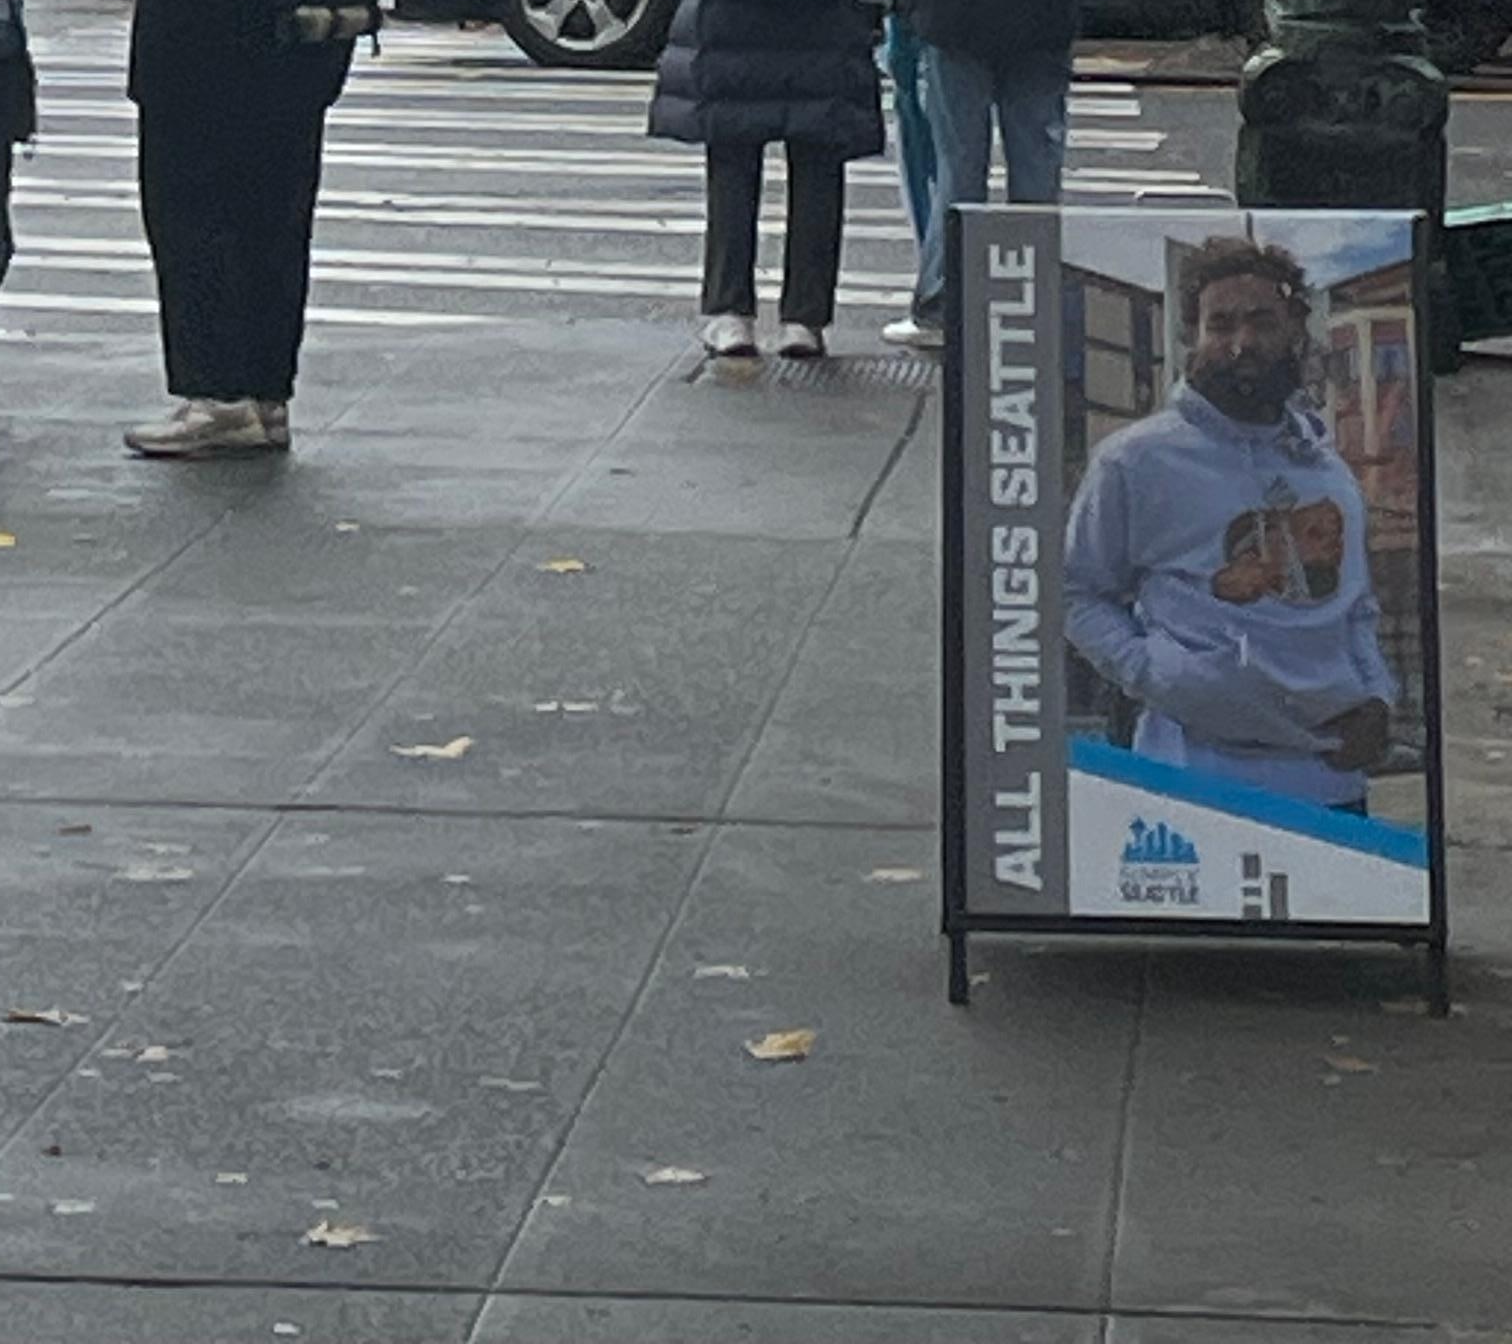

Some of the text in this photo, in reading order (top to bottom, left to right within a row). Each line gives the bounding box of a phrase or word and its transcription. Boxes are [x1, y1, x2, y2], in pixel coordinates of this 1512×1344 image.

[988, 243, 1043, 892] ALL THINGS SEATTLE
